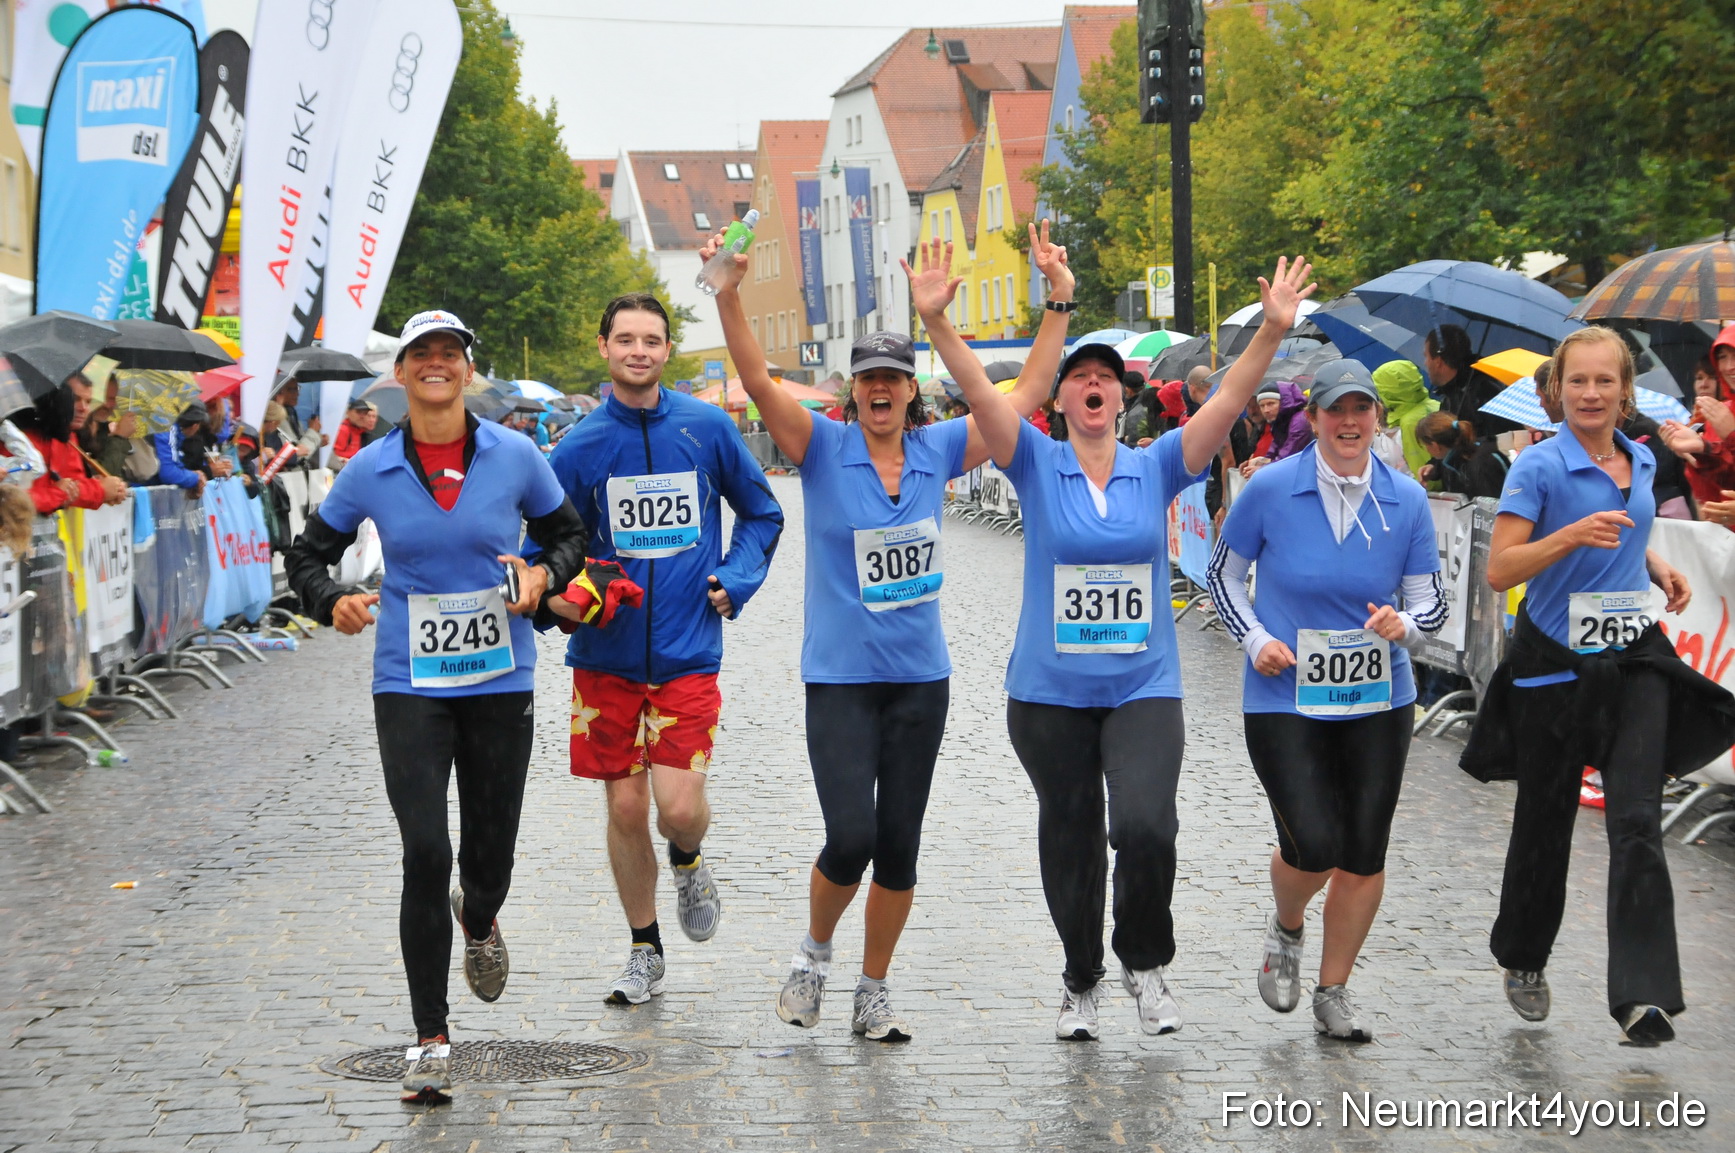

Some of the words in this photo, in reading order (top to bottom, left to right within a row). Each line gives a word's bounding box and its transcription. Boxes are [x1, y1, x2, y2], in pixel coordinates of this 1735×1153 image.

[86, 68, 167, 113] maxi
[132, 130, 160, 158] dsl
[267, 184, 303, 291] Audi
[286, 81, 319, 174] BKK
[162, 83, 247, 331] THULE
[347, 222, 380, 310] Audi
[366, 138, 398, 214] BKK
[618, 495, 692, 529] 3025
[629, 534, 684, 547] Johannes
[866, 541, 935, 583] 3087
[883, 582, 928, 600] Cornelia
[1065, 588, 1143, 621] 3316
[420, 613, 500, 654] 3243
[1080, 628, 1128, 641] Martina
[440, 659, 486, 674] Andrea
[1307, 648, 1383, 684] 3028
[1329, 690, 1362, 703] Linda
